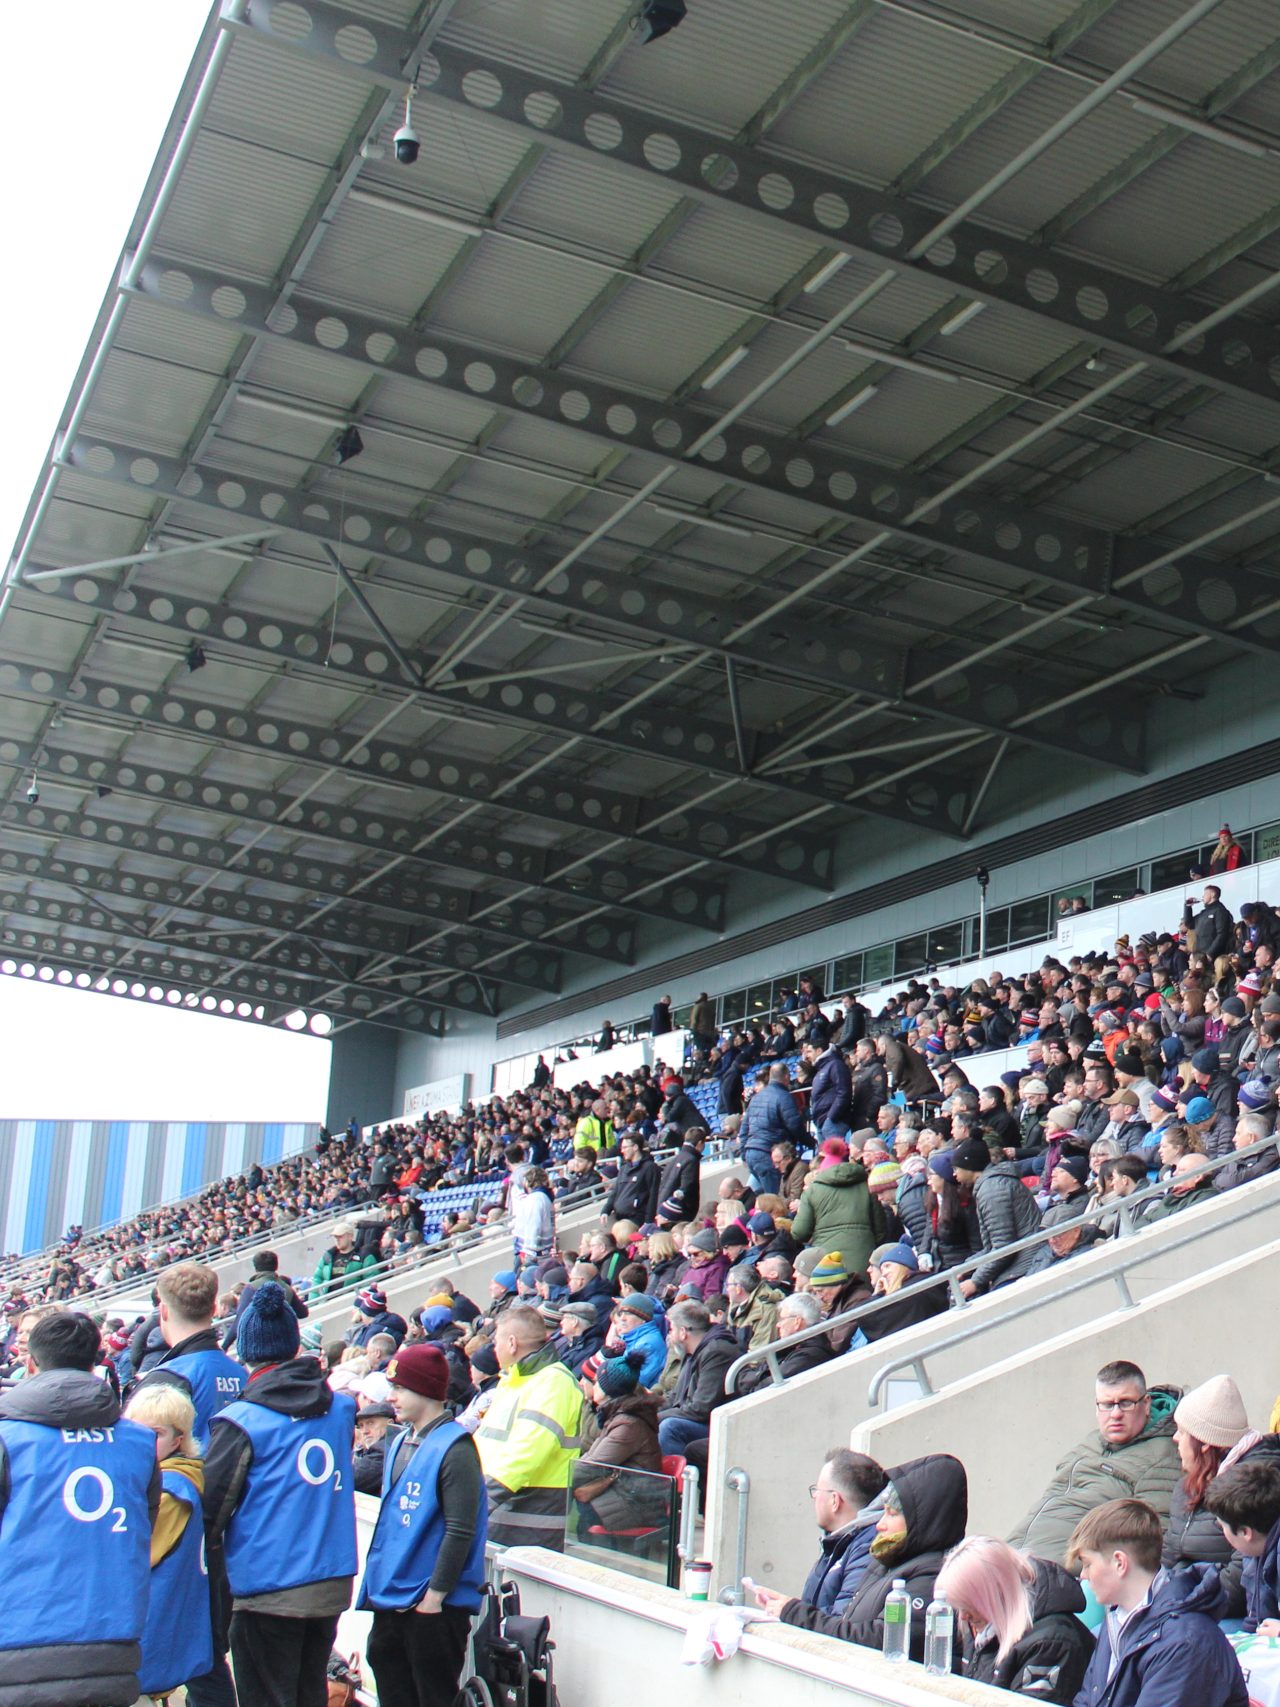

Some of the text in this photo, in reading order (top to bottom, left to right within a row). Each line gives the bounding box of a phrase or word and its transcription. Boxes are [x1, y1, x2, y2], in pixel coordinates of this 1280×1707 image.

[215, 1376, 240, 1392] EAST
[62, 1427, 114, 1443] EAST
[406, 1481, 421, 1496] 12
